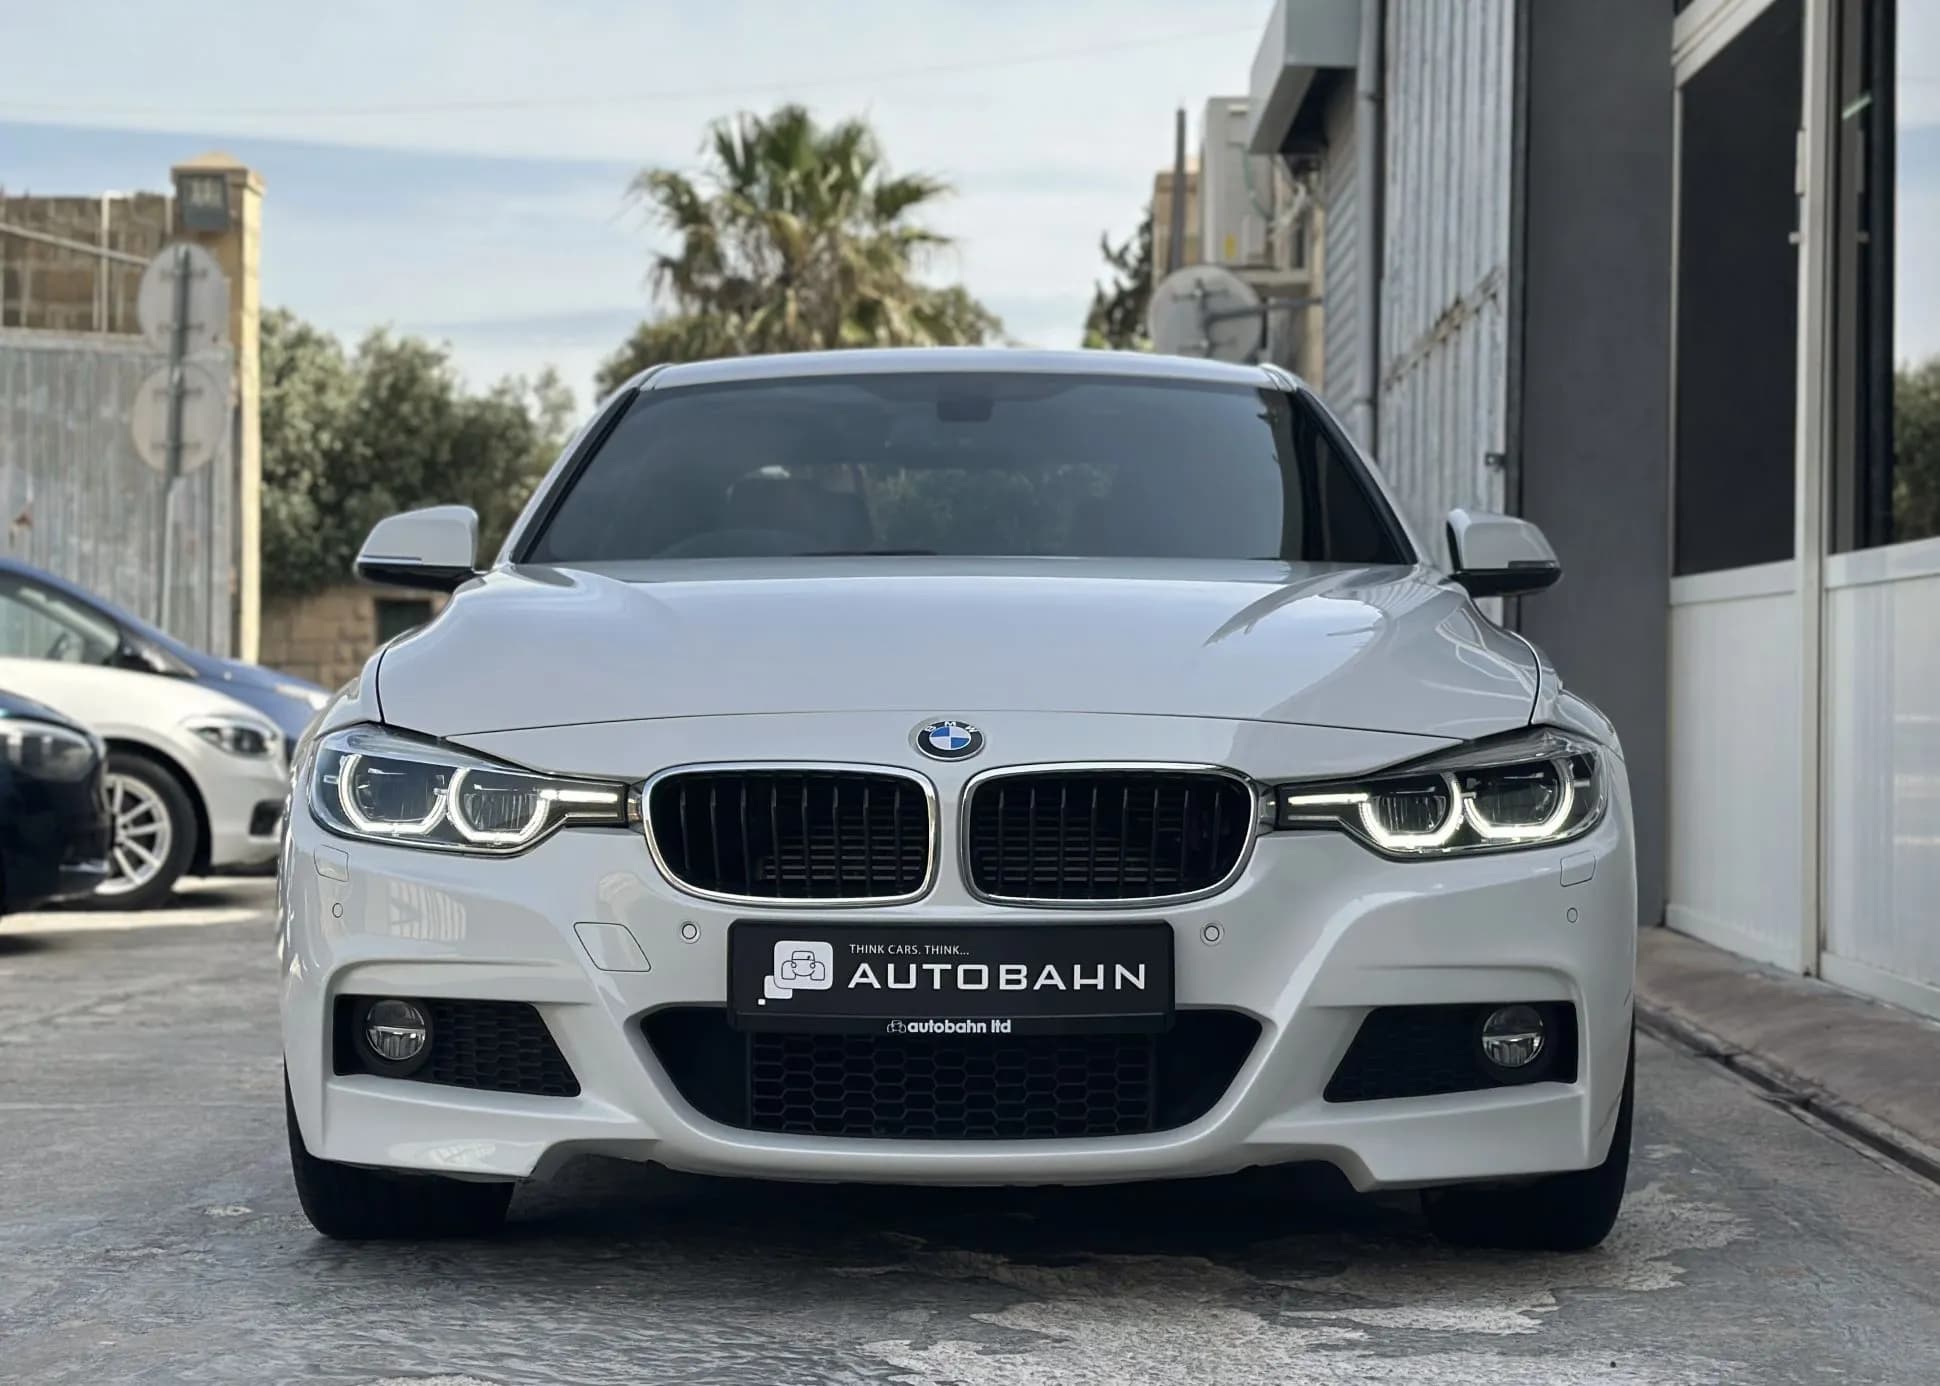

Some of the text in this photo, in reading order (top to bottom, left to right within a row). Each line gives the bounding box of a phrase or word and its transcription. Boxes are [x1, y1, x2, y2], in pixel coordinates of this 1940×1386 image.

[924, 720, 980, 733] BMW
[849, 944, 970, 956] THINK CARS. THINK...
[847, 962, 1146, 990] AUTOBAHN
[907, 1019, 1012, 1033] autobahn ltd
